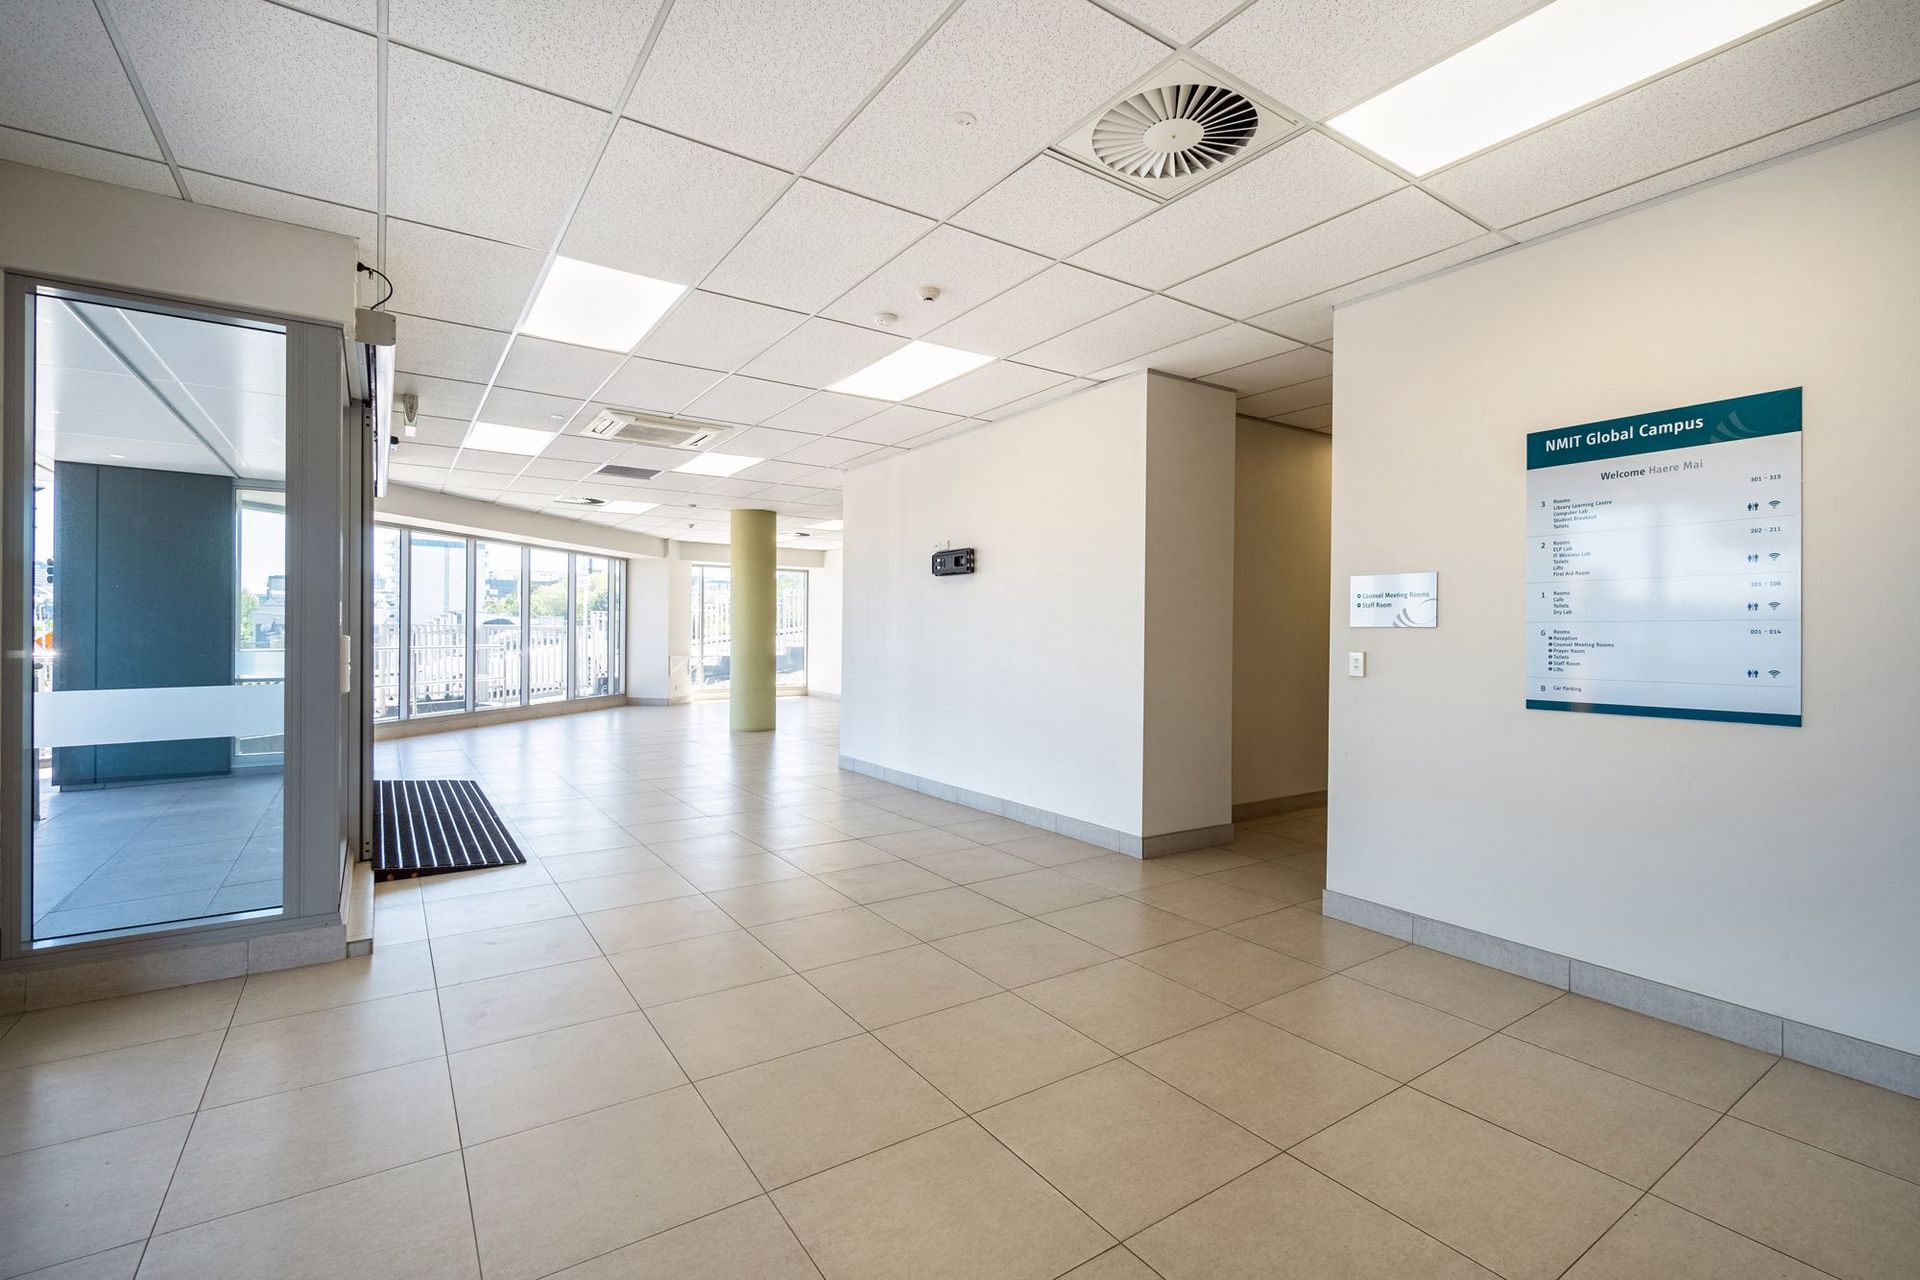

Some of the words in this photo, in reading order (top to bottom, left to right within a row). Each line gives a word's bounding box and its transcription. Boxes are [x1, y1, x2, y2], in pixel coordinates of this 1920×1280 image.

[1545, 435, 1583, 452] NMIT
[1586, 426, 1634, 445] Global
[1639, 418, 1704, 436] Campus
[1600, 467, 1646, 481] Welcome
[1648, 464, 1679, 475] Haere
[1683, 459, 1703, 470] Mai
